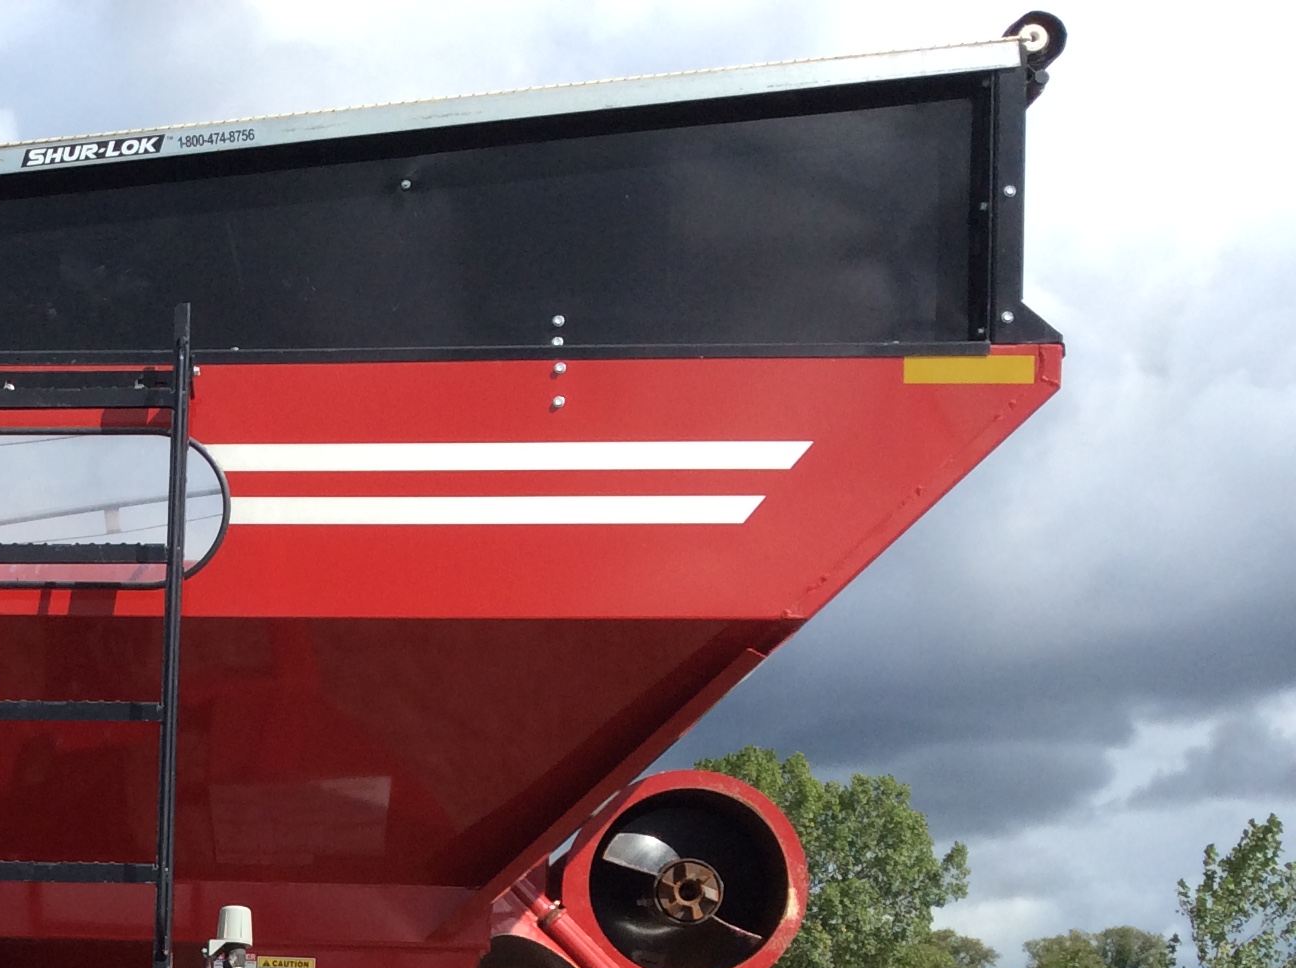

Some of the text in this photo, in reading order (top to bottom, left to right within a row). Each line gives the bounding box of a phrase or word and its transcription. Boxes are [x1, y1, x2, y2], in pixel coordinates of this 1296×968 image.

[26, 137, 160, 166] SHUR-LOK
[177, 128, 255, 149] 1-800-474-8756
[272, 960, 309, 968] CAUTION
